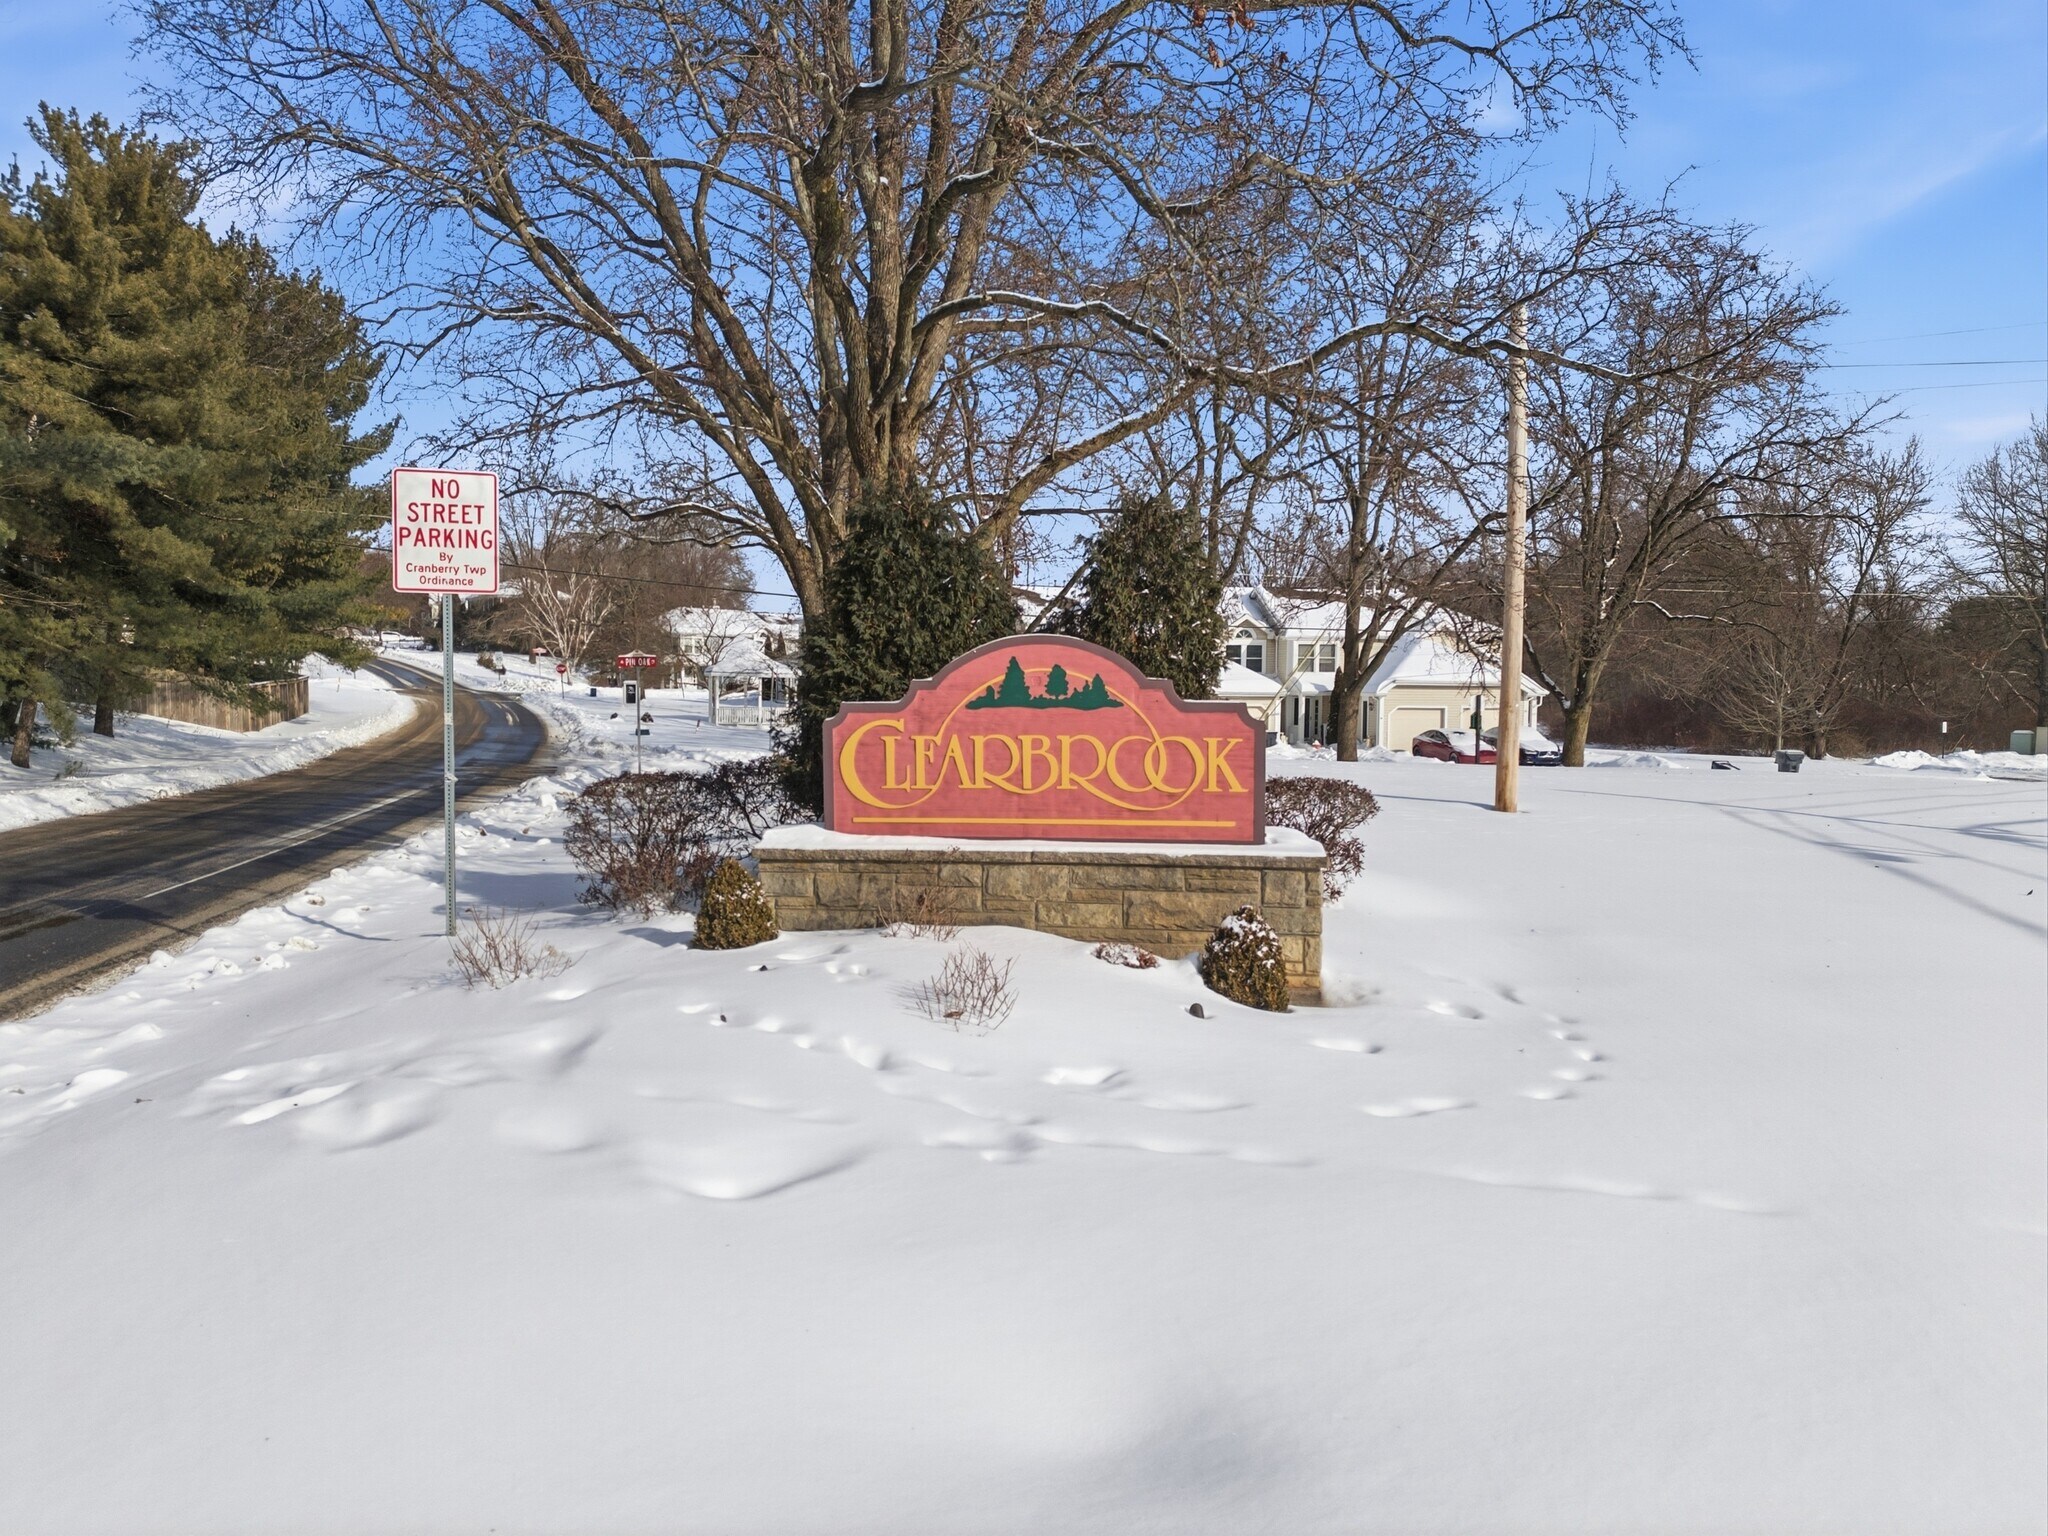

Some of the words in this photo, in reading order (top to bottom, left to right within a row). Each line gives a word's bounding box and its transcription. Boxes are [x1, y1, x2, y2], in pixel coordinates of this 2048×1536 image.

[432, 479, 460, 499] NO
[407, 502, 485, 525] STREET
[399, 526, 493, 550] PARKING
[440, 552, 453, 563] By
[406, 562, 460, 576] Cranberry
[464, 564, 487, 576] Twp
[419, 575, 474, 586] Ordinance
[839, 718, 1250, 811] CLEARBROOK
